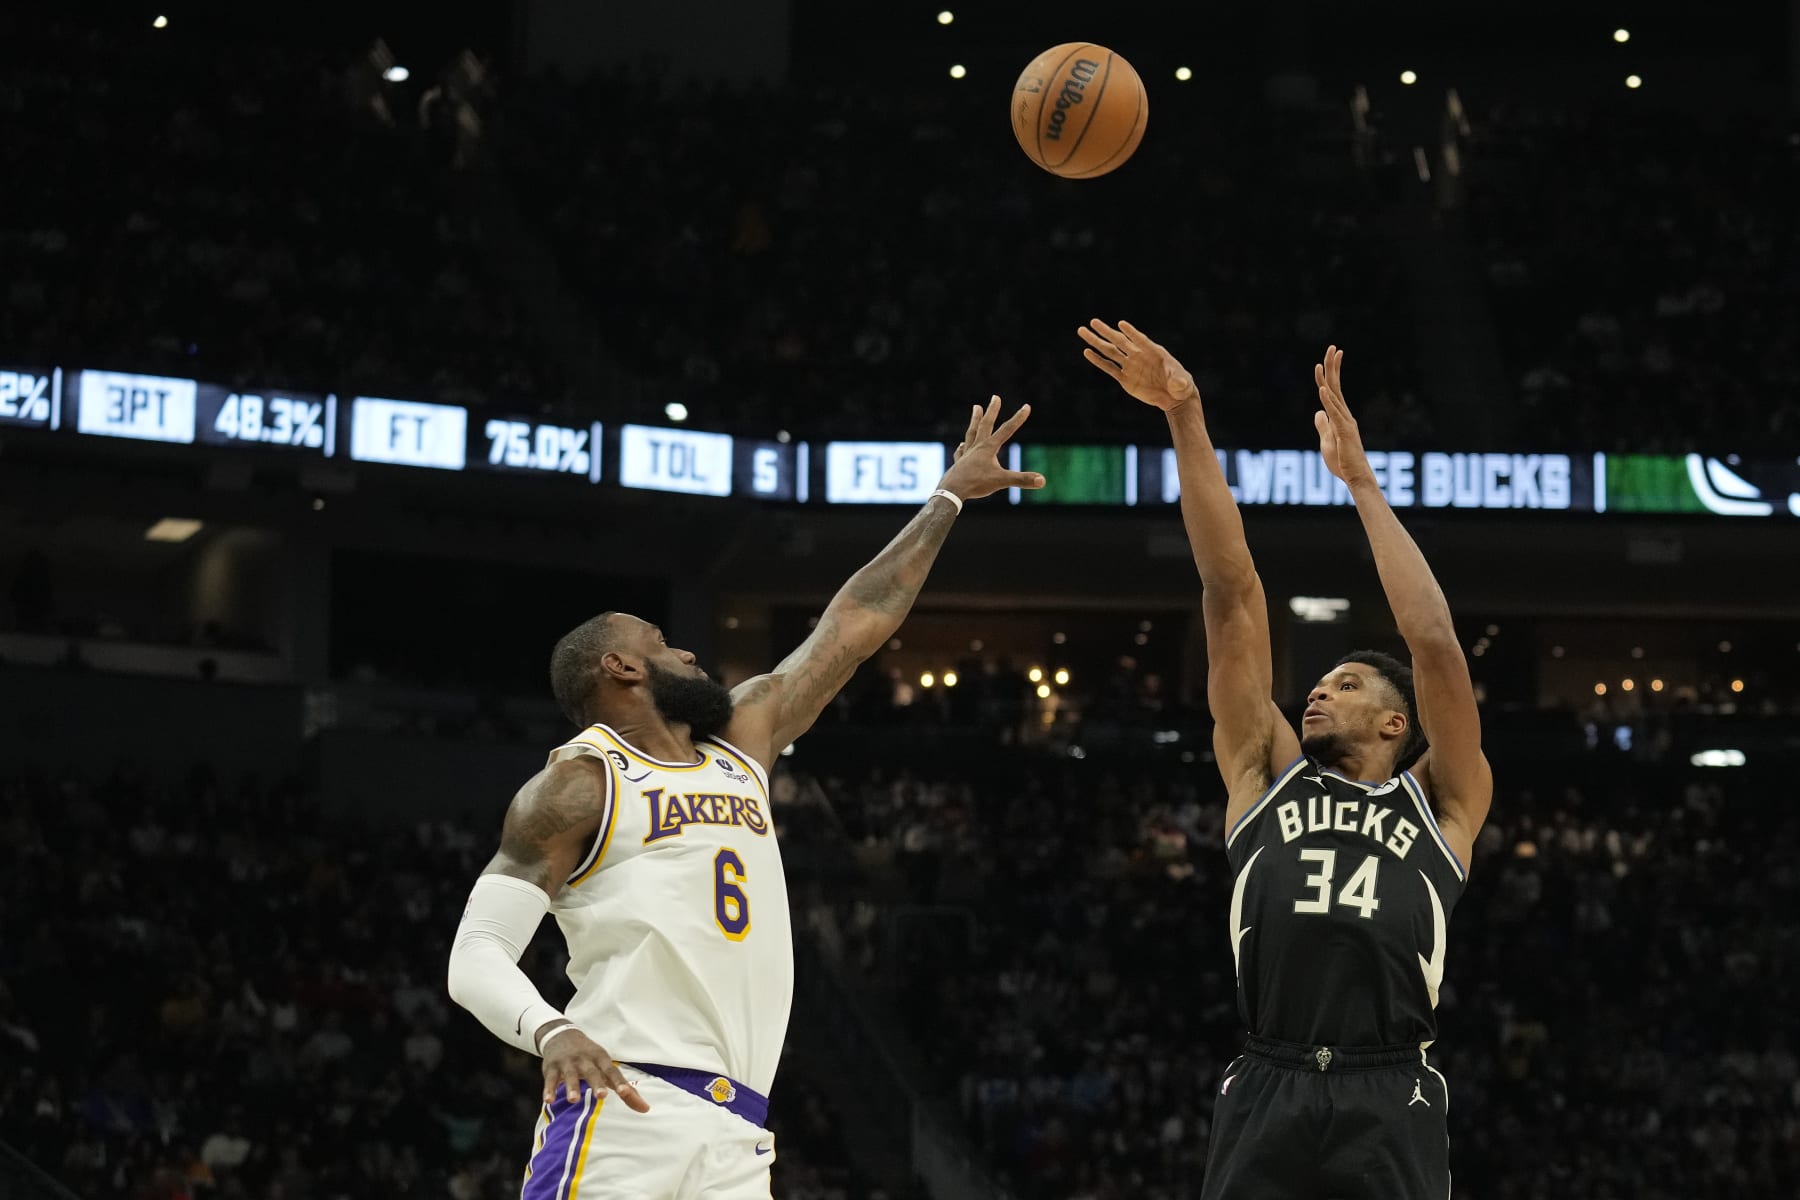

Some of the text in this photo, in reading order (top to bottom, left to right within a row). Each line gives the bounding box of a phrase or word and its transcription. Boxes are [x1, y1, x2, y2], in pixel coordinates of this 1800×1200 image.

[1046, 58, 1099, 141] Wilson
[106, 385, 323, 448] 3PT 48.3%
[390, 413, 590, 475] FT 75.0%
[647, 440, 779, 493] TOL 5
[854, 455, 919, 491] FLS
[1421, 451, 1571, 509] BUCKS
[641, 786, 768, 846] LAKERS
[1276, 795, 1421, 861] BUCKS
[713, 846, 751, 942] 6
[1293, 848, 1381, 920] 34
